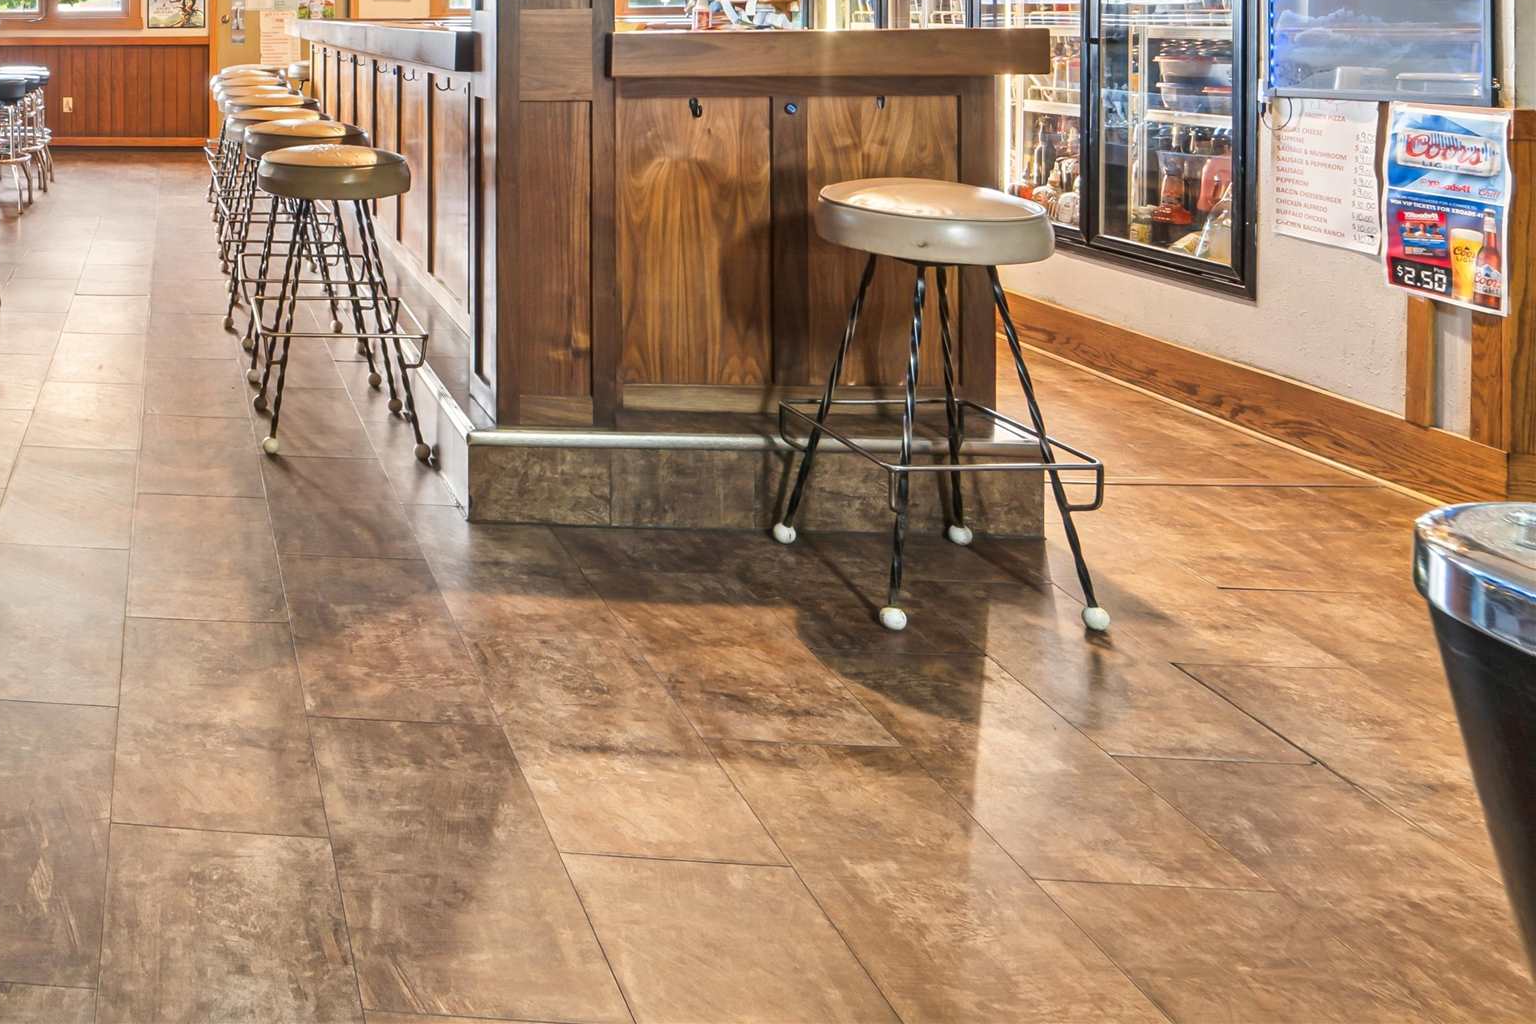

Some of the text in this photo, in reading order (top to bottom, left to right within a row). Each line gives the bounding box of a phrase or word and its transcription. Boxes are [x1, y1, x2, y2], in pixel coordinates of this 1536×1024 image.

[1406, 134, 1482, 166] Coors
[1276, 165, 1304, 175] SAUSAGE
[1276, 186, 1298, 195] BACON
[1303, 202, 1328, 213] ALFREDO
[1413, 201, 1437, 210] TICKETS
